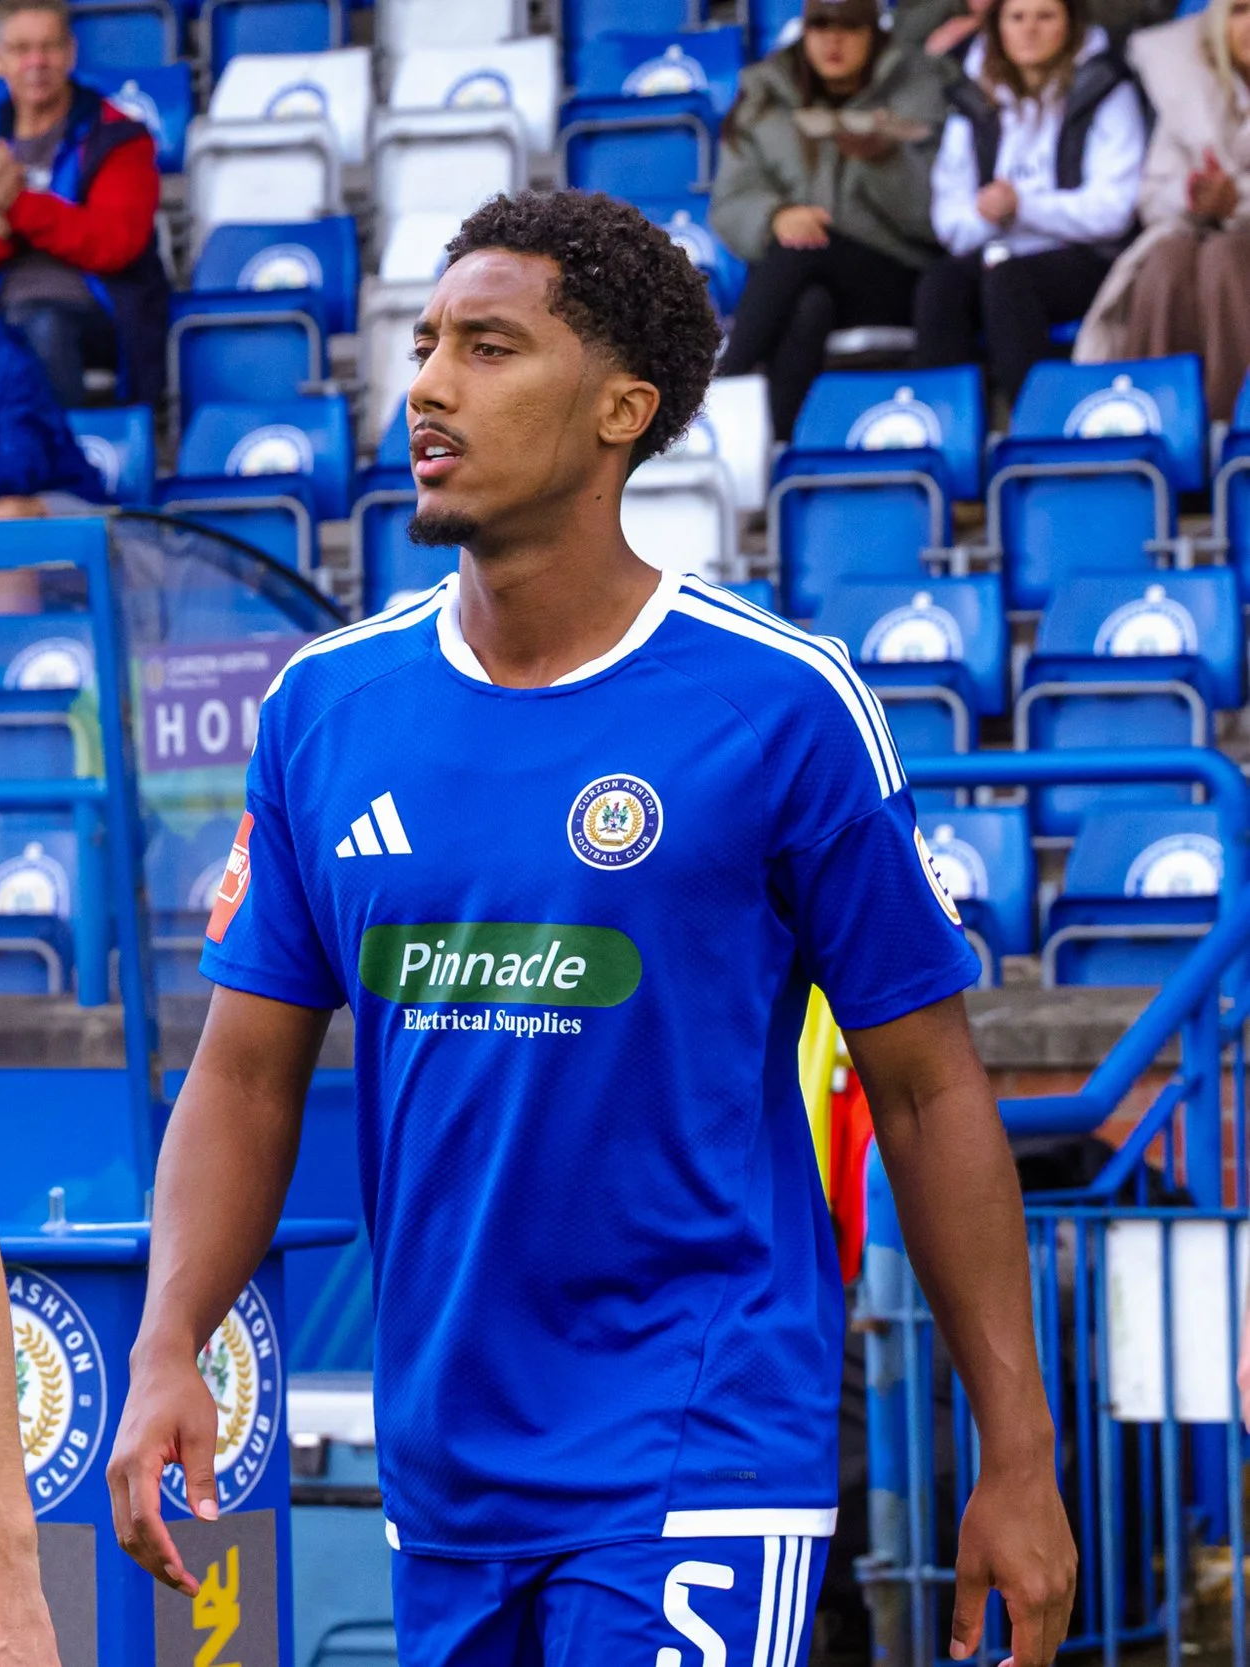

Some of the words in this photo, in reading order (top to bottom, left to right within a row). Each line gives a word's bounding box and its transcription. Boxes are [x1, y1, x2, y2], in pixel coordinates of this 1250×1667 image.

[578, 780, 618, 810] CURZON
[622, 781, 656, 815] ASHTON
[575, 832, 622, 862] FOOTBALL
[626, 835, 650, 858] CLUB
[399, 939, 586, 990] Pinnacle
[403, 1009, 491, 1031] Electrical
[493, 1009, 582, 1038] Supplies
[9, 1276, 93, 1373] ASHTON
[35, 1429, 89, 1498] CLUB
[234, 1414, 271, 1486] CLUB
